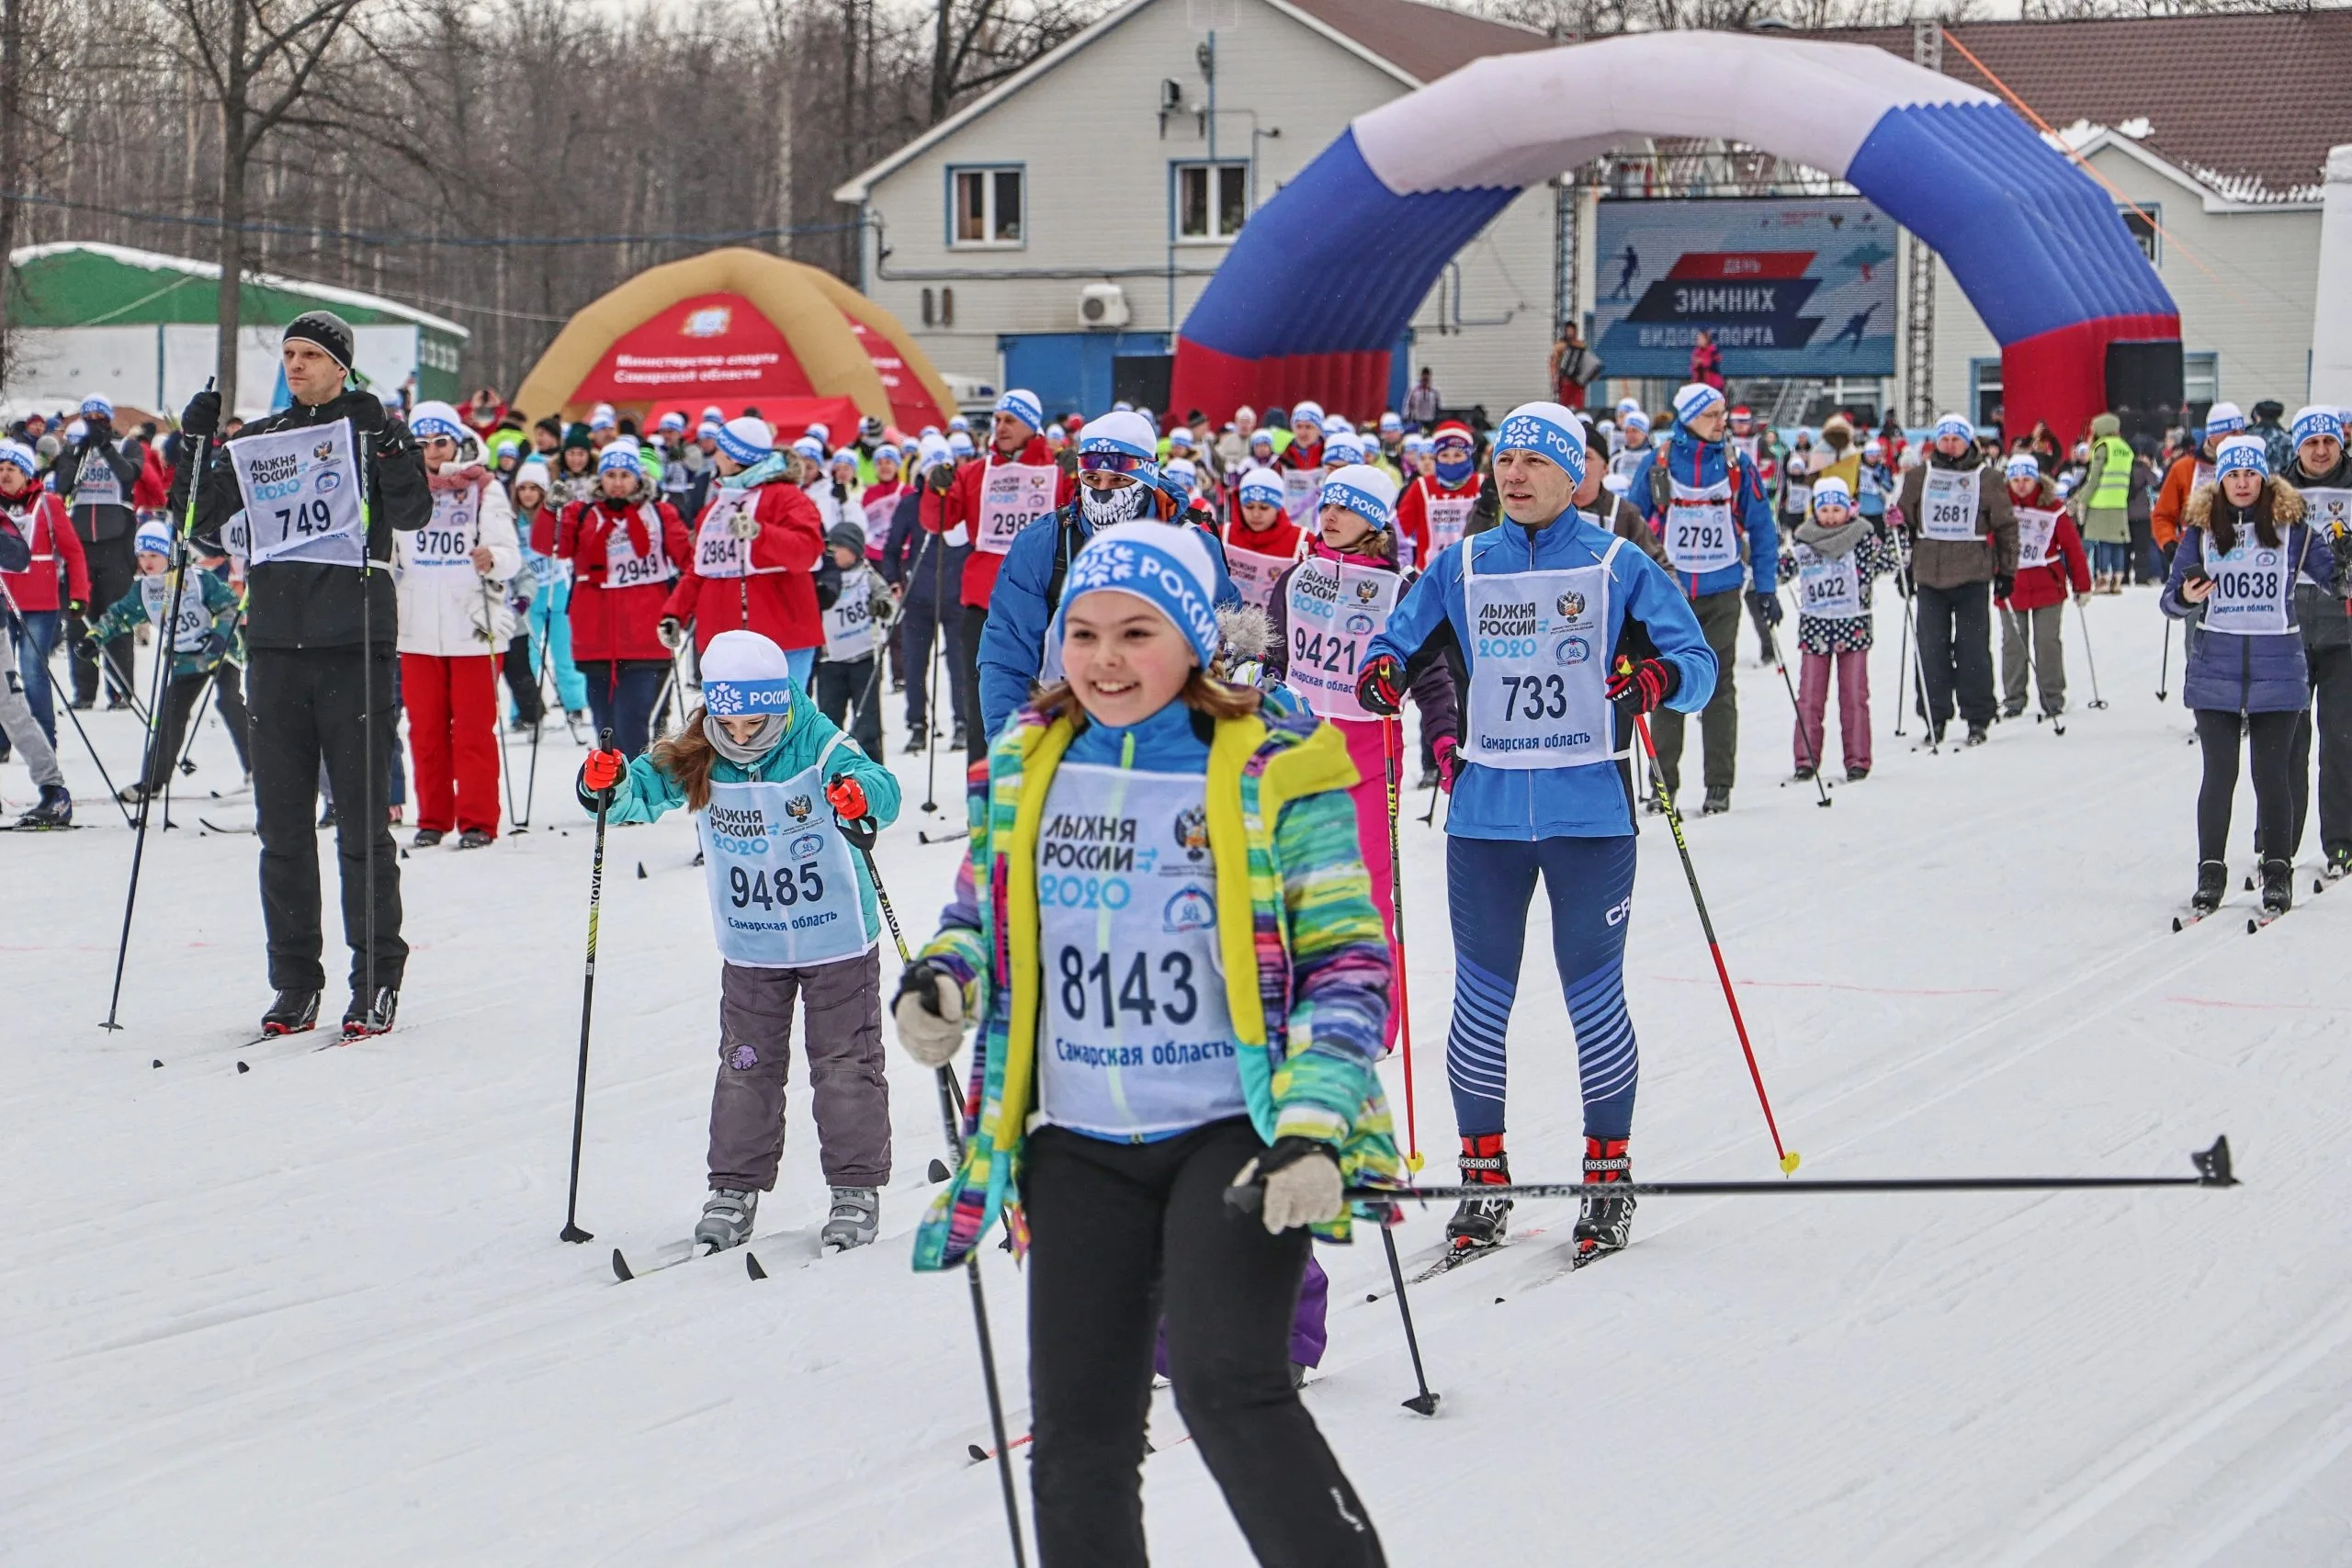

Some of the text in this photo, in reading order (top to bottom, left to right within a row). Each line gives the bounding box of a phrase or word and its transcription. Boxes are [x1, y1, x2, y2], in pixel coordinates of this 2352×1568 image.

[1723, 258, 1761, 273] ДЕНЬ
[1674, 288, 1776, 312] ЗИМНИХ
[616, 355, 725, 367] Министерство
[249, 454, 296, 472] ЛЫЖНЯ
[252, 465, 298, 484] РОССИИ
[254, 479, 301, 501] 2020
[275, 499, 331, 542] 749
[1933, 505, 1969, 523] 2681
[416, 530, 465, 555] 9706
[1678, 525, 1724, 548] 2792
[702, 538, 737, 565] 2984
[616, 553, 659, 583] 2949
[2215, 571, 2278, 599] 10638
[1293, 593, 1335, 619] 2020
[1478, 602, 1536, 619] ЛЫЖНЯ
[1479, 619, 1536, 636] РОССИИ
[1295, 626, 1357, 676] 9421
[1477, 637, 1537, 659] 2020
[1290, 665, 1323, 688] амарская
[1501, 673, 1567, 722] 733
[1611, 687, 1632, 702] LEKI
[1482, 732, 1590, 752] Самарская область
[708, 803, 763, 824] ЛЫЖНЯ
[710, 818, 766, 838] РОССИИ
[1045, 814, 1136, 843] ЛЫЖНЯ
[712, 832, 770, 856] 2020
[1042, 843, 1135, 873] РОССИИ
[730, 861, 823, 912] 9485
[1039, 874, 1131, 910] 2020
[728, 909, 838, 932] Самарская область
[1059, 944, 1198, 1029] 8143
[1056, 1038, 1234, 1067] Самарская область
